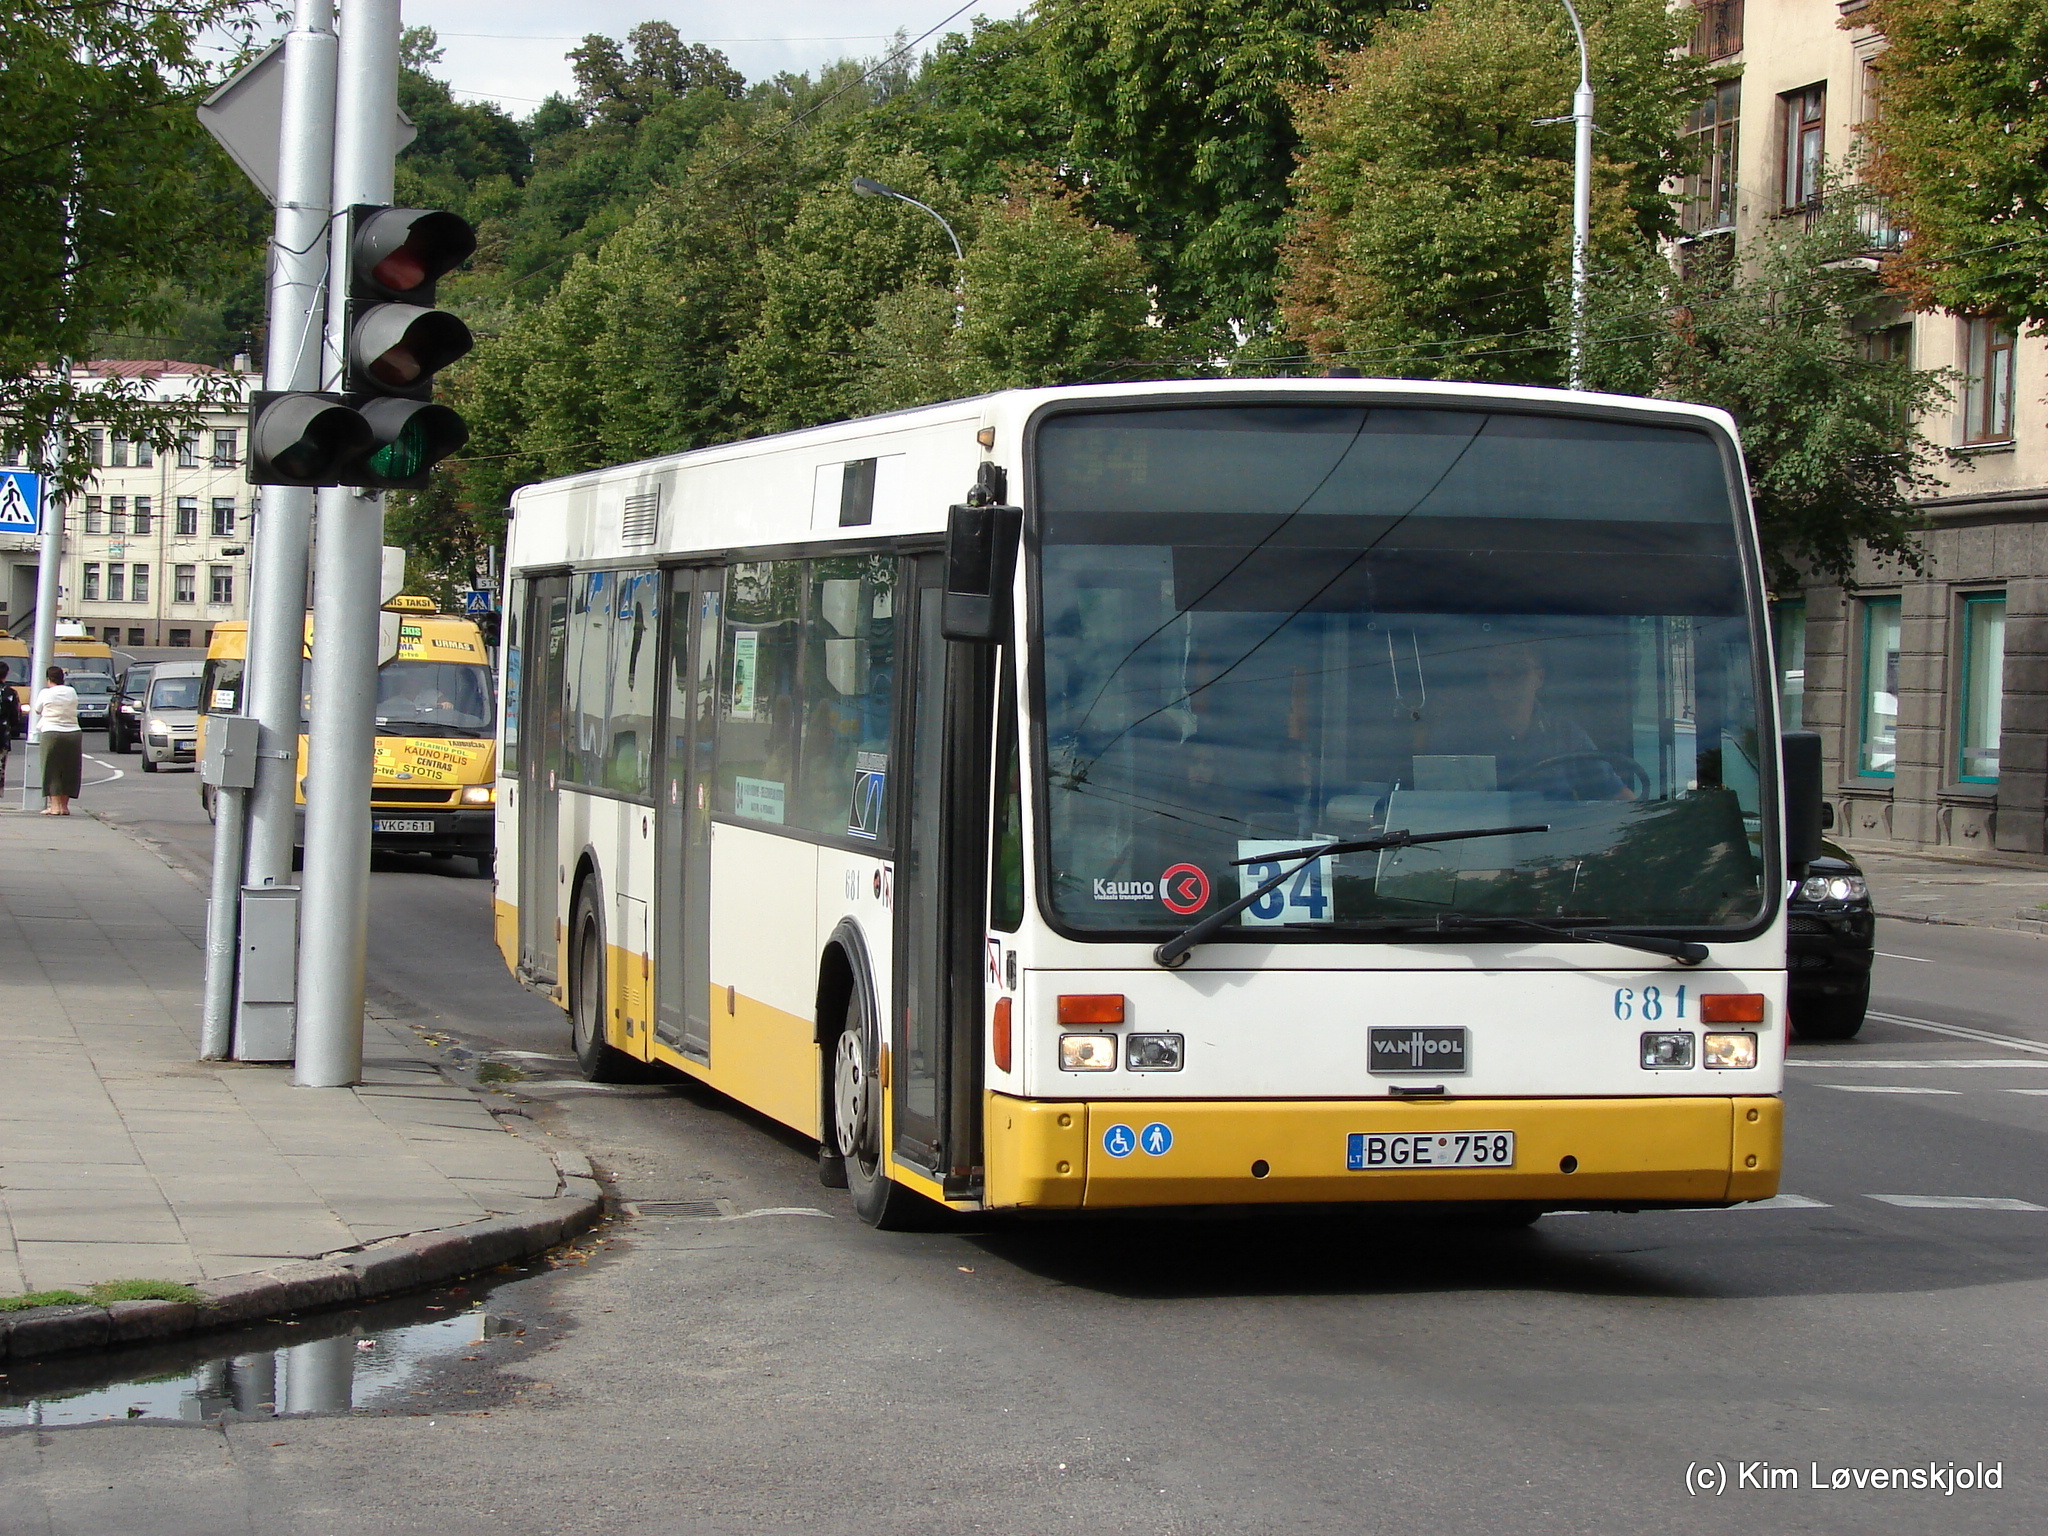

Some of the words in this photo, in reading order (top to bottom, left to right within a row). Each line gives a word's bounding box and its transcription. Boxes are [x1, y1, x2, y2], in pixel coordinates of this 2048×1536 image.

[481, 579, 500, 587] STO
[405, 599, 431, 608] TAKSI
[435, 639, 471, 651] URMAS
[404, 746, 441, 759] KAUNO
[442, 753, 468, 766] PILIS
[402, 764, 443, 780] STOTIS
[416, 757, 453, 772] CENTRAS
[381, 821, 405, 831] VKG
[412, 821, 432, 832] 611
[845, 869, 860, 901] 681
[1093, 878, 1155, 894] Kauno
[1247, 857, 1328, 920] 34
[1614, 984, 1686, 1021] 681
[1349, 1154, 1362, 1164] LT
[1367, 1136, 1433, 1165] BGE
[1454, 1135, 1508, 1163] 758
